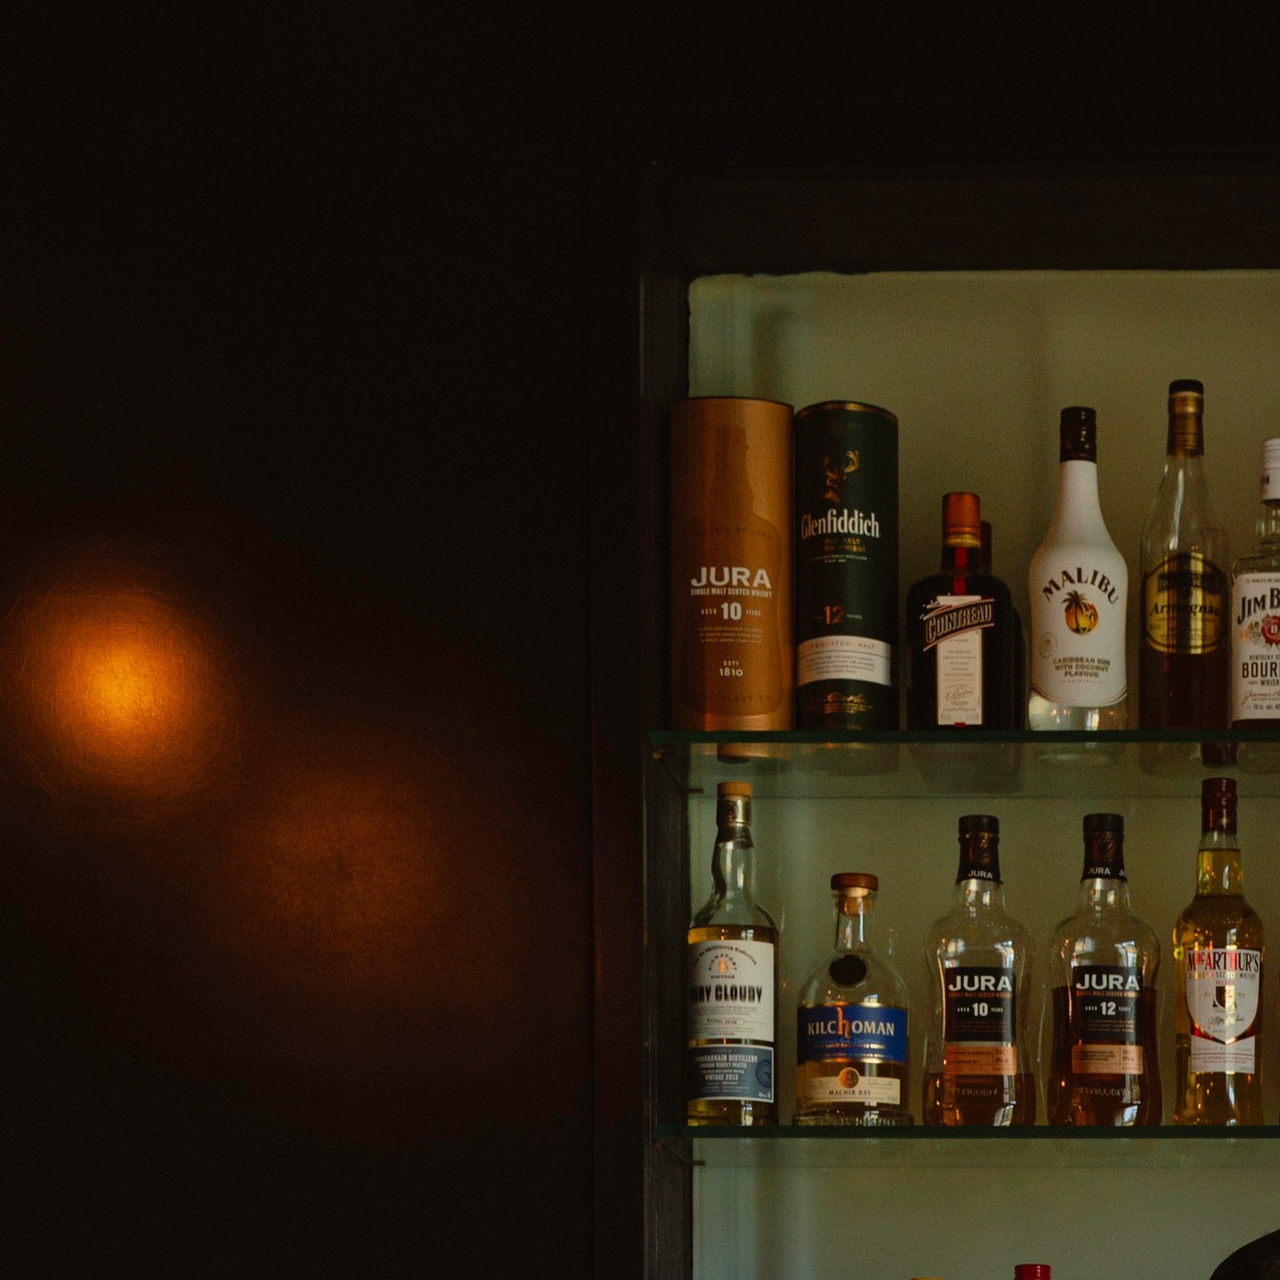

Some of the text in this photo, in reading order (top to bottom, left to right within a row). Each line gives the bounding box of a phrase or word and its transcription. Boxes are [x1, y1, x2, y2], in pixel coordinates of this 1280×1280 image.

[800, 508, 880, 540] Glenfiddich
[690, 566, 772, 589] JURA
[1042, 568, 1119, 604] MALIBU
[690, 588, 710, 596] SINGLE
[727, 588, 750, 596] SCOTCH
[750, 588, 772, 598] WHISKY
[721, 602, 742, 621] 10
[824, 605, 843, 624] 12
[1237, 596, 1266, 625] JIM
[925, 604, 992, 644] COINTREAU
[1052, 657, 1095, 665] CARIBBEAN
[1075, 664, 1109, 672] COCONUT
[967, 869, 993, 879] JURA
[1088, 867, 1111, 876] JURA
[948, 975, 1013, 991] JURA
[1076, 974, 1140, 991] JURA
[715, 984, 762, 1003] CLOUDY
[972, 1002, 988, 1017] 10
[1100, 1001, 1116, 1015] 12
